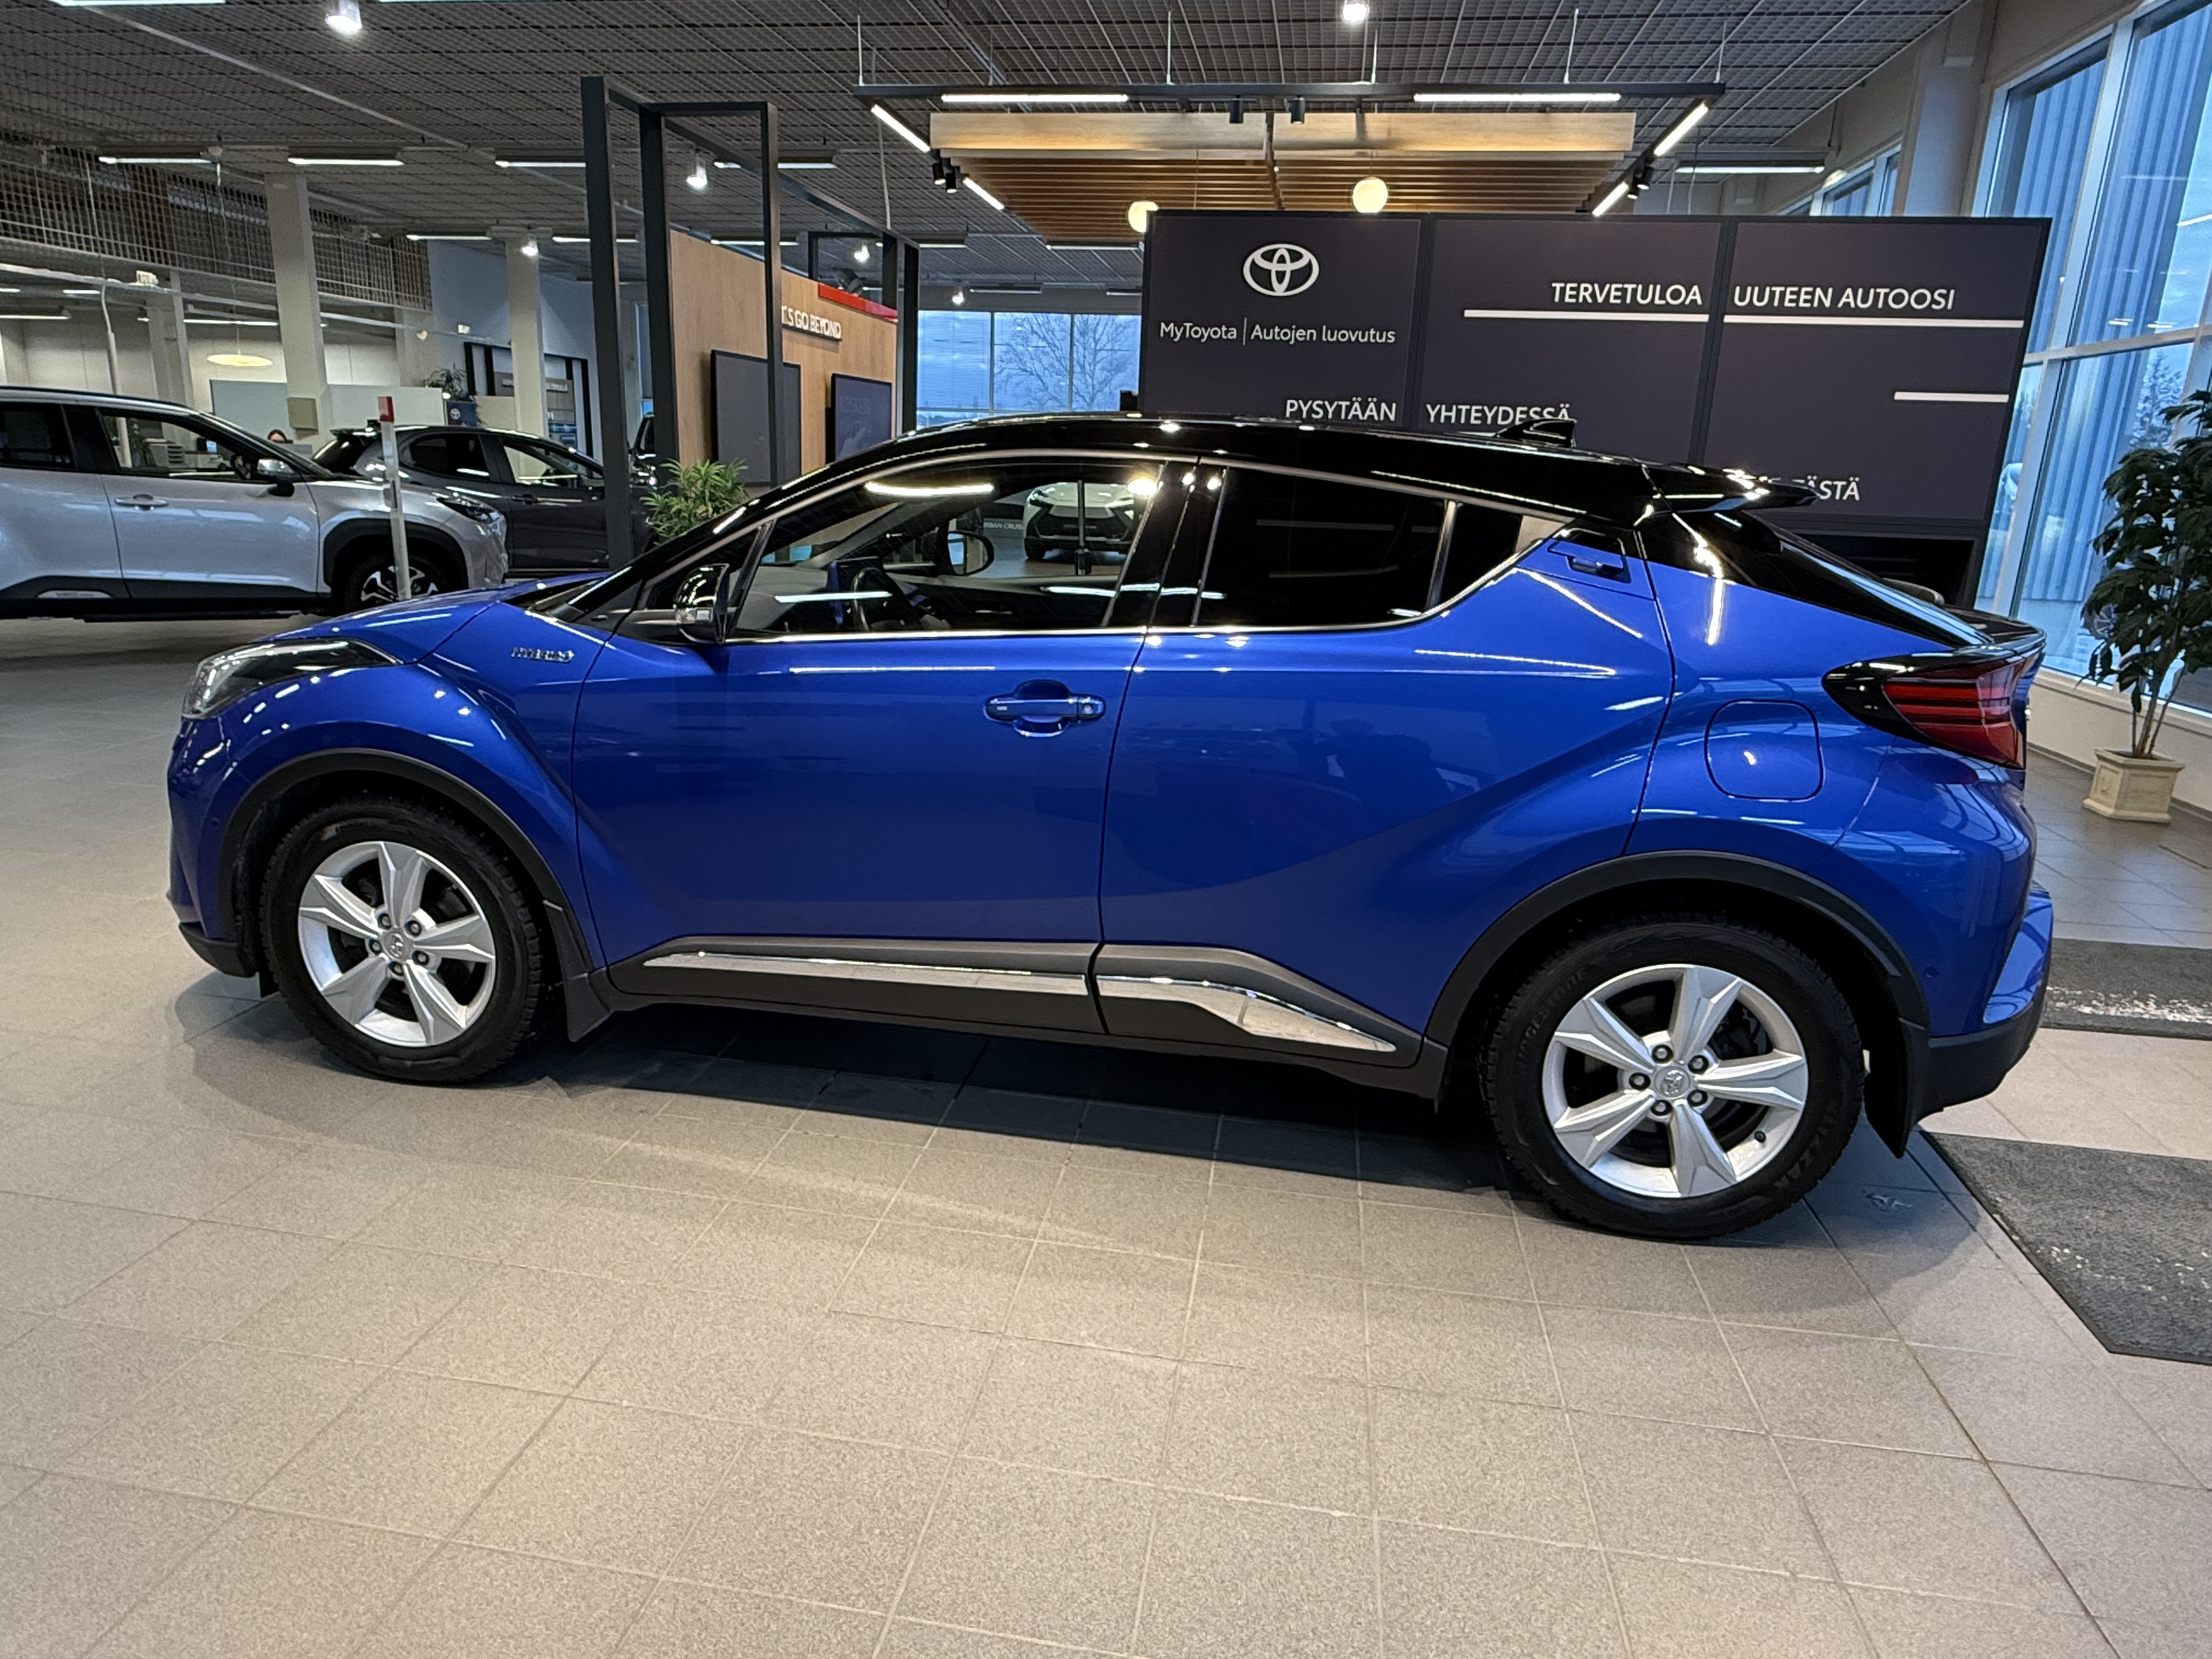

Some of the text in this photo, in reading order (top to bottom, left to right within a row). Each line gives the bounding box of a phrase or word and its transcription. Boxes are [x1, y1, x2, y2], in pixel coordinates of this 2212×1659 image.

[1551, 282, 1955, 310] TERVETULOA UUTEEN AUTOOSI
[794, 310, 809, 330] GO
[1160, 321, 1396, 345] MyToyota Autojen luovutus
[1285, 397, 1570, 425] PYSYTÄÄN YHTEYDESSÄ
